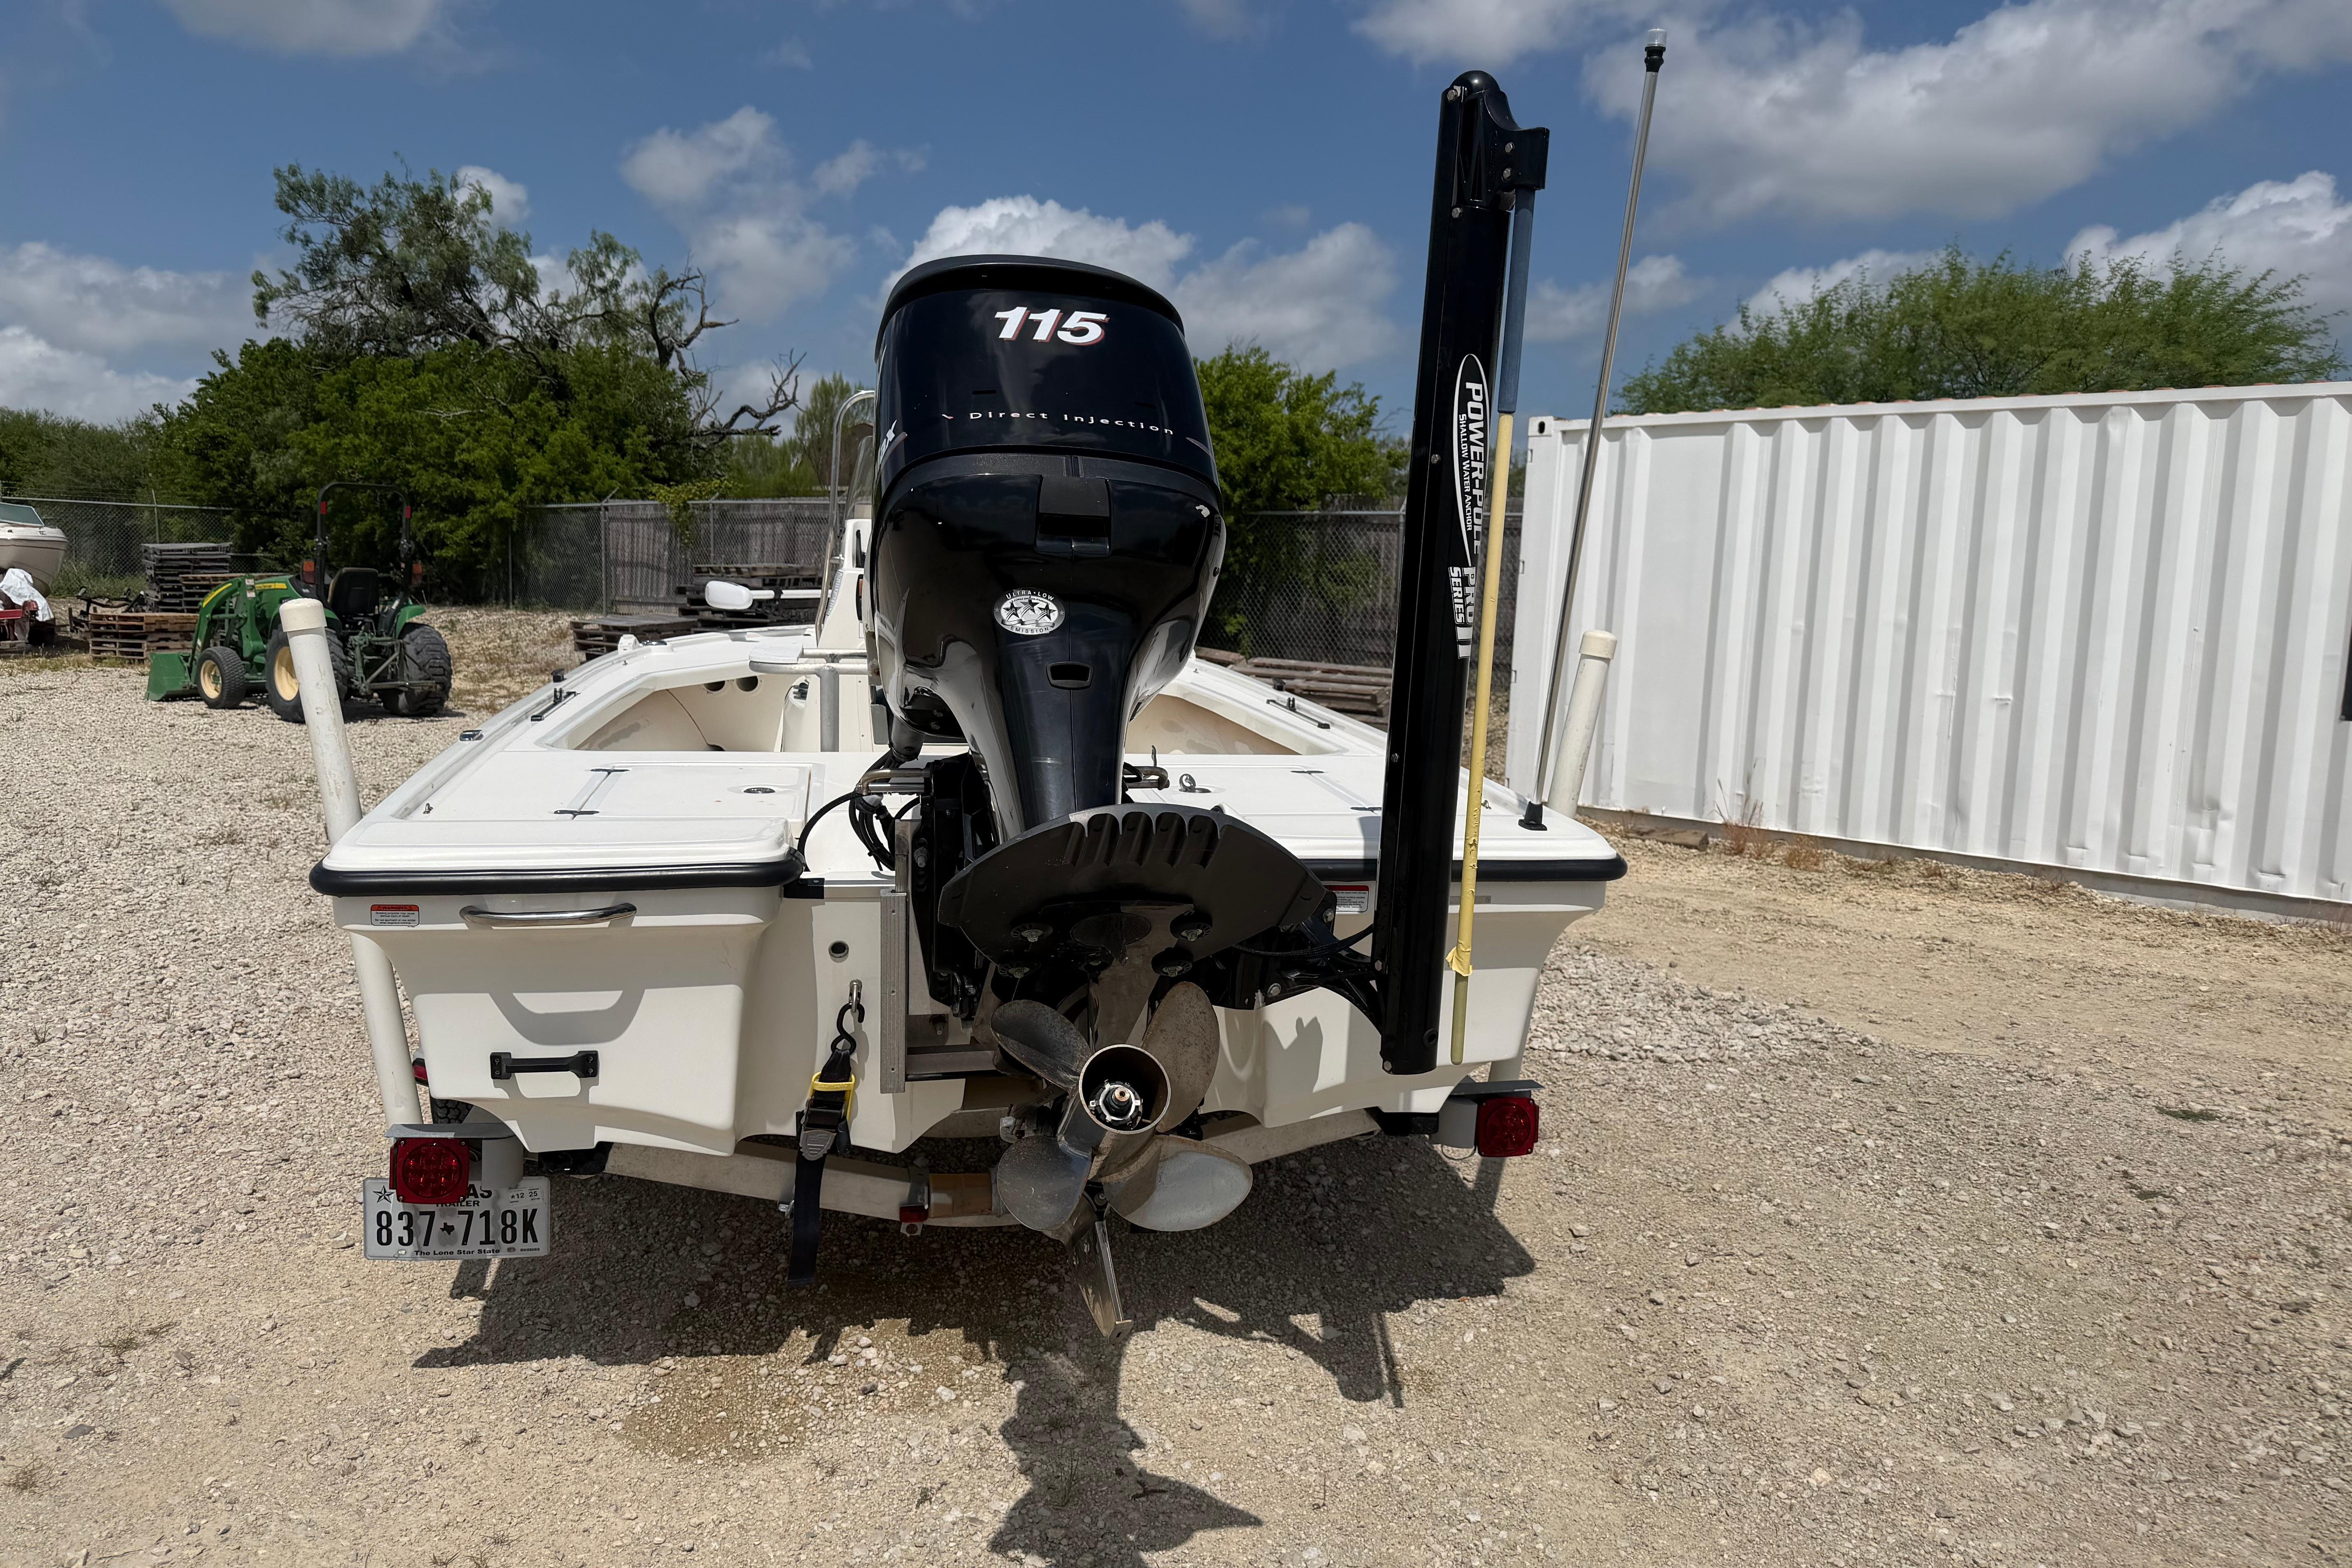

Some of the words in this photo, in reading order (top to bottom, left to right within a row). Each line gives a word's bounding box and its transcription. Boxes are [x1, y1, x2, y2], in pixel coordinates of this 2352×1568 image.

[994, 306, 1109, 345] 115
[1064, 414, 1173, 435] Injection
[1459, 413, 1468, 458] SHALLOW
[1462, 460, 1470, 492] WATER
[1465, 382, 1484, 554] POWER-POLE
[1449, 567, 1465, 623] SERIES
[1463, 567, 1476, 623] PRO
[376, 1211, 435, 1246] 837
[457, 1209, 538, 1246] 718K
